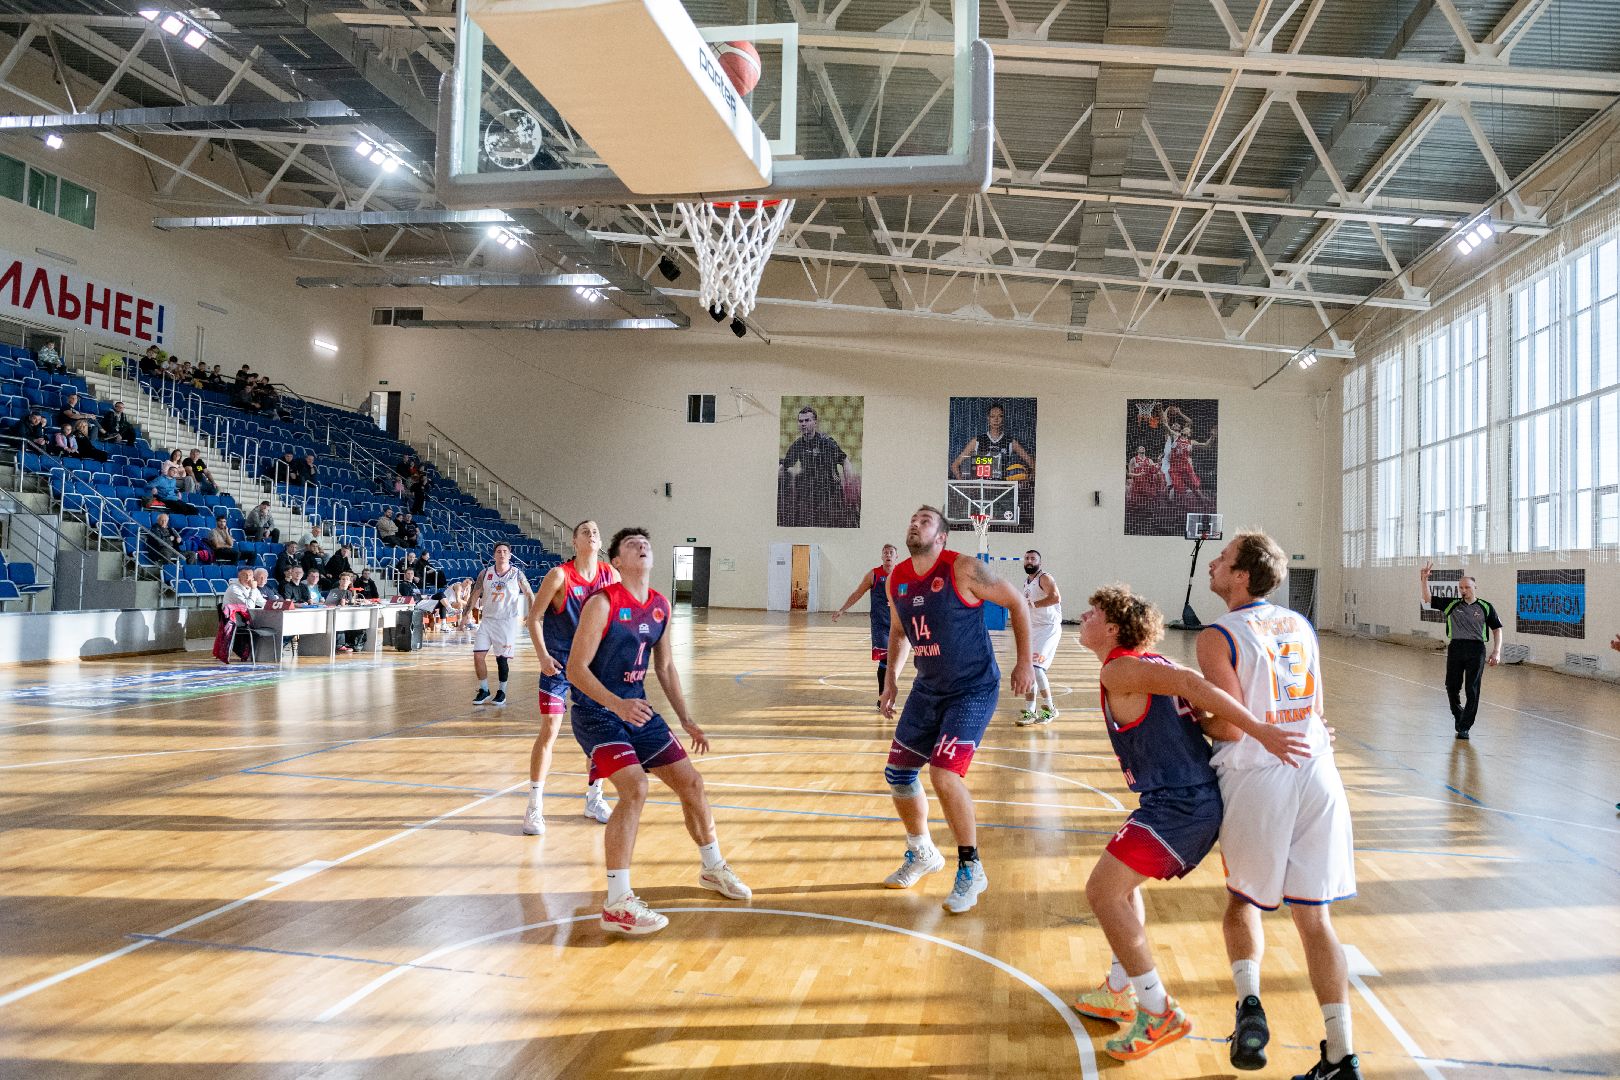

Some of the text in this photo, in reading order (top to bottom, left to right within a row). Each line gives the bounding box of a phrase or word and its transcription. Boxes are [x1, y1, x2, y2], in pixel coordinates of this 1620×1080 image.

[1519, 592, 1580, 616] ВОЛЕЙБОЛ
[911, 615, 931, 641] 14
[1264, 641, 1315, 702] 13
[936, 733, 958, 760] 14
